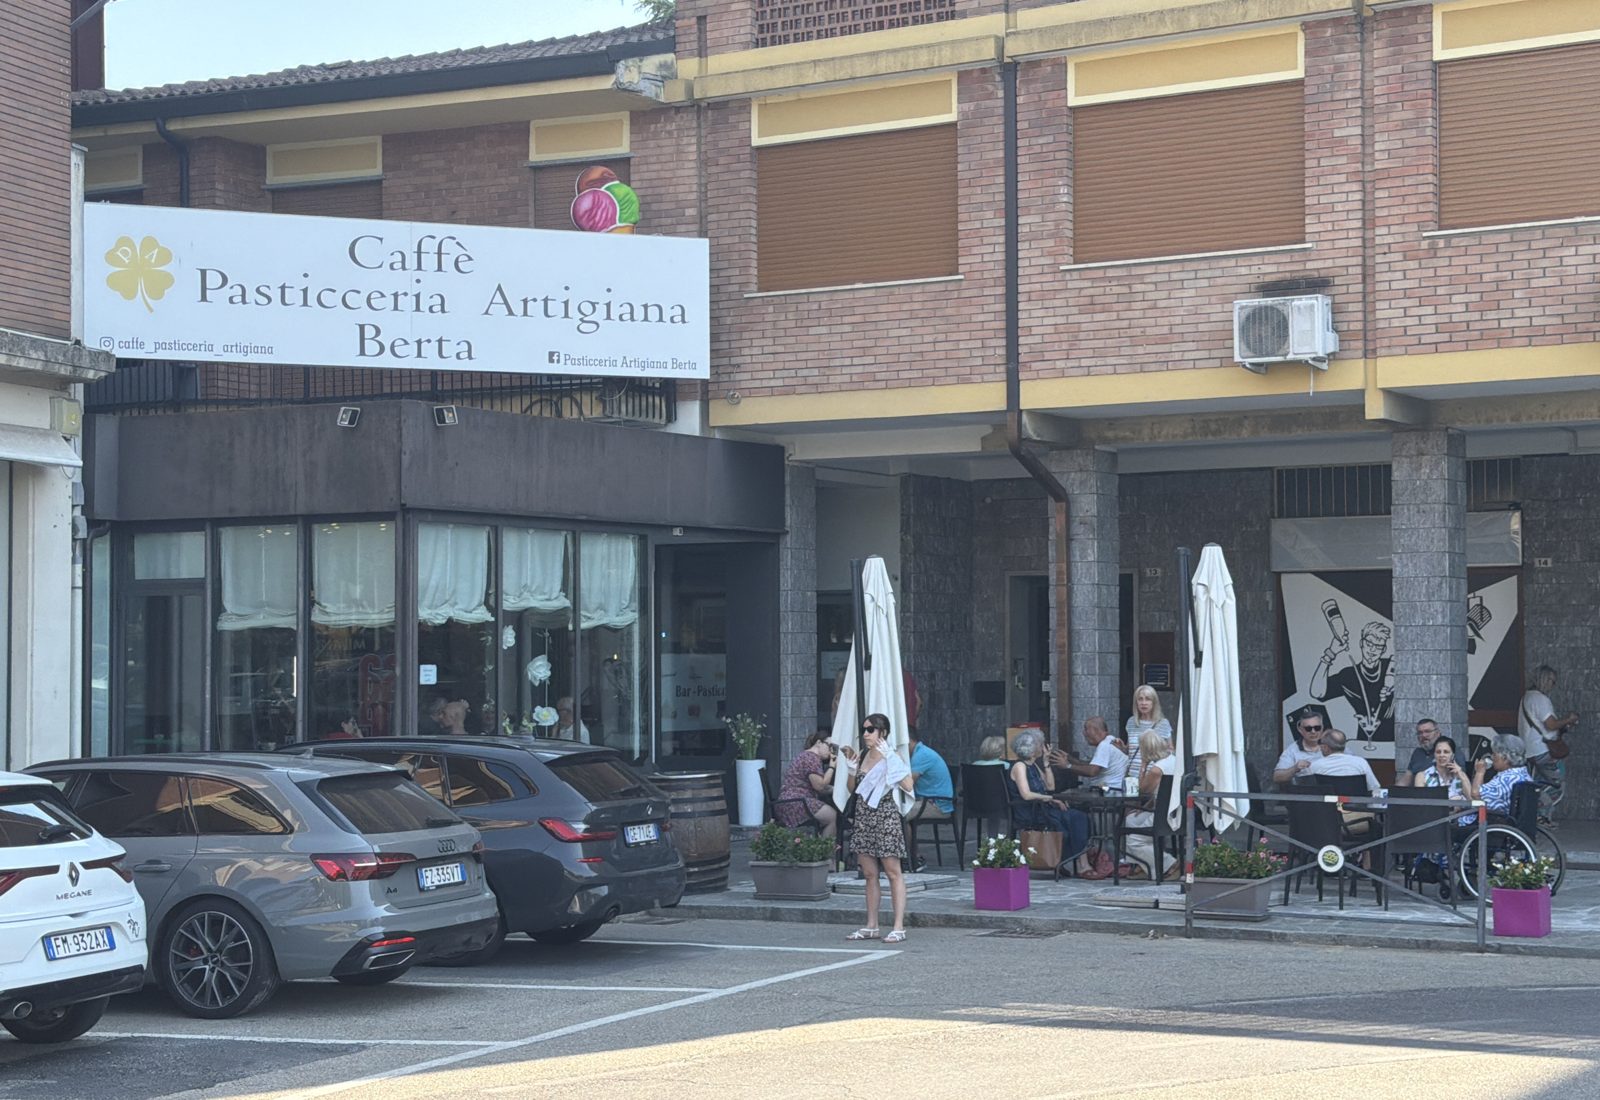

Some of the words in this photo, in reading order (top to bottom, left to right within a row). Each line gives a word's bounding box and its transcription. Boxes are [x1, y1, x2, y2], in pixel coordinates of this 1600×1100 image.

[348, 234, 474, 275] Caffè
[196, 267, 450, 314] Pasticceria
[481, 282, 690, 335] Artigiana
[118, 336, 274, 357] caffe_pasticceria_artigiana
[354, 322, 477, 361] Berta
[563, 353, 618, 367] Pasticceria
[620, 355, 668, 371] Artigiana
[671, 357, 697, 370] Berta
[55, 889, 93, 901] MEGANE
